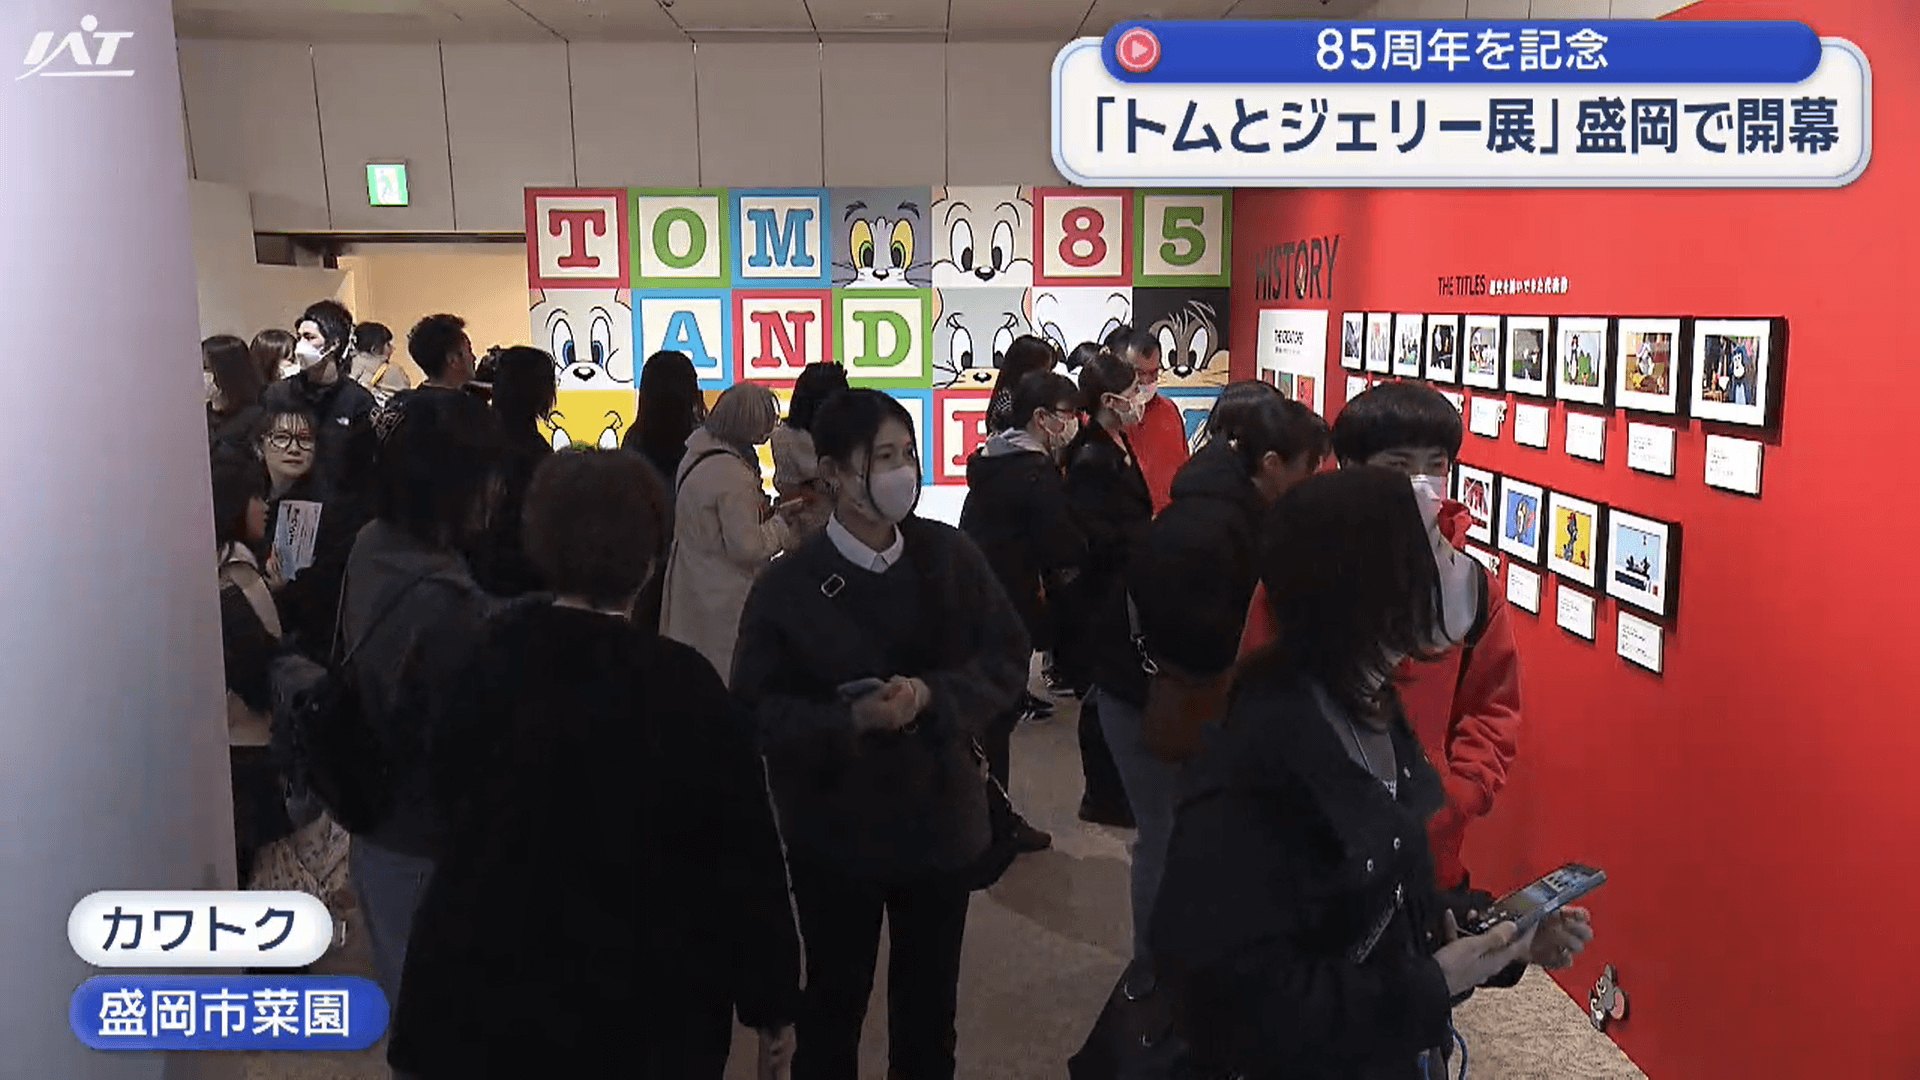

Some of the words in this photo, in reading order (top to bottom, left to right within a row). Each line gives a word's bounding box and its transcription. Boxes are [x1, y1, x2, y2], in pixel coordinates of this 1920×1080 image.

[548, 208, 815, 269] TOM
[1058, 206, 1208, 269] 85
[1255, 234, 1339, 299] HISTORY
[1438, 276, 1453, 295] THE
[1456, 275, 1485, 295] TITLES
[661, 310, 912, 368] AND
